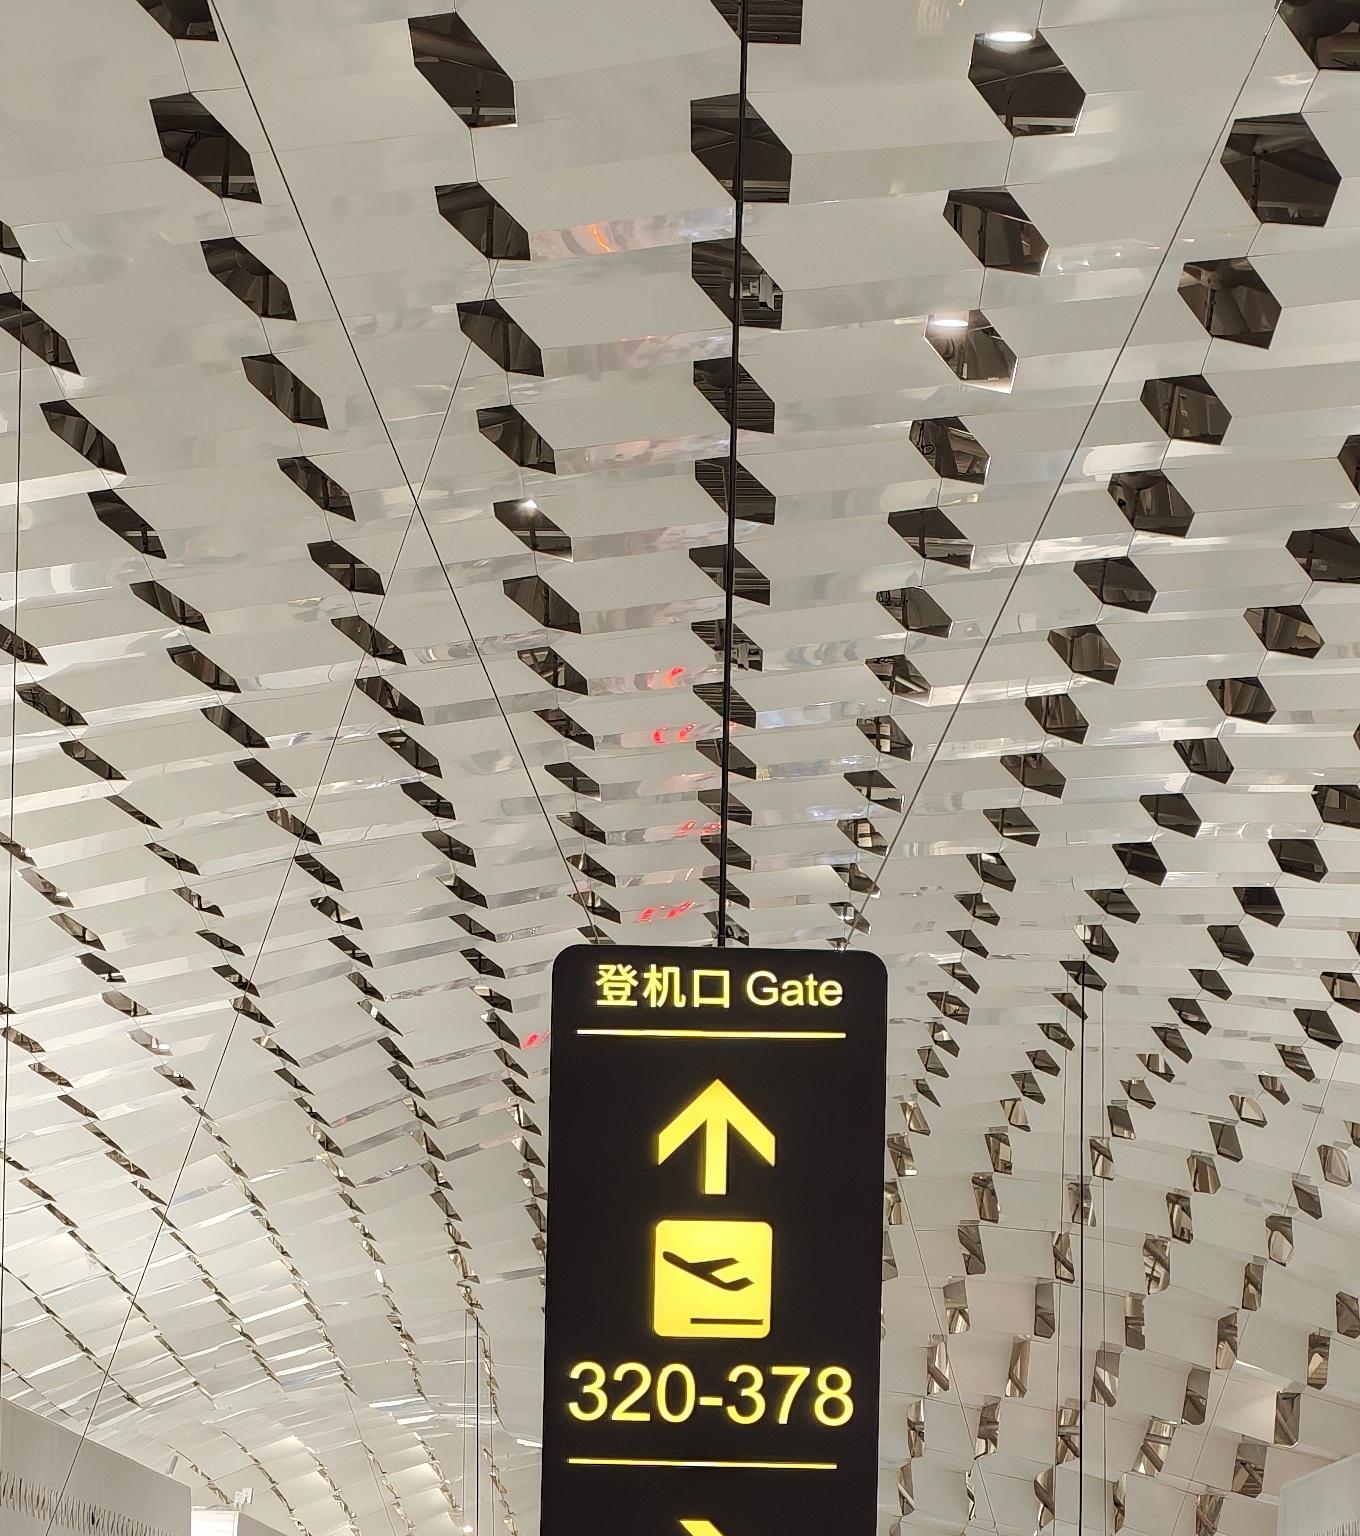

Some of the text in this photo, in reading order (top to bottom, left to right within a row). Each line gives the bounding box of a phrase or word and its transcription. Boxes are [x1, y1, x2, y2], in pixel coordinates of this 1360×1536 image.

[595, 963, 843, 1008] 登机口 Gate
[568, 1361, 854, 1427] 320-378
